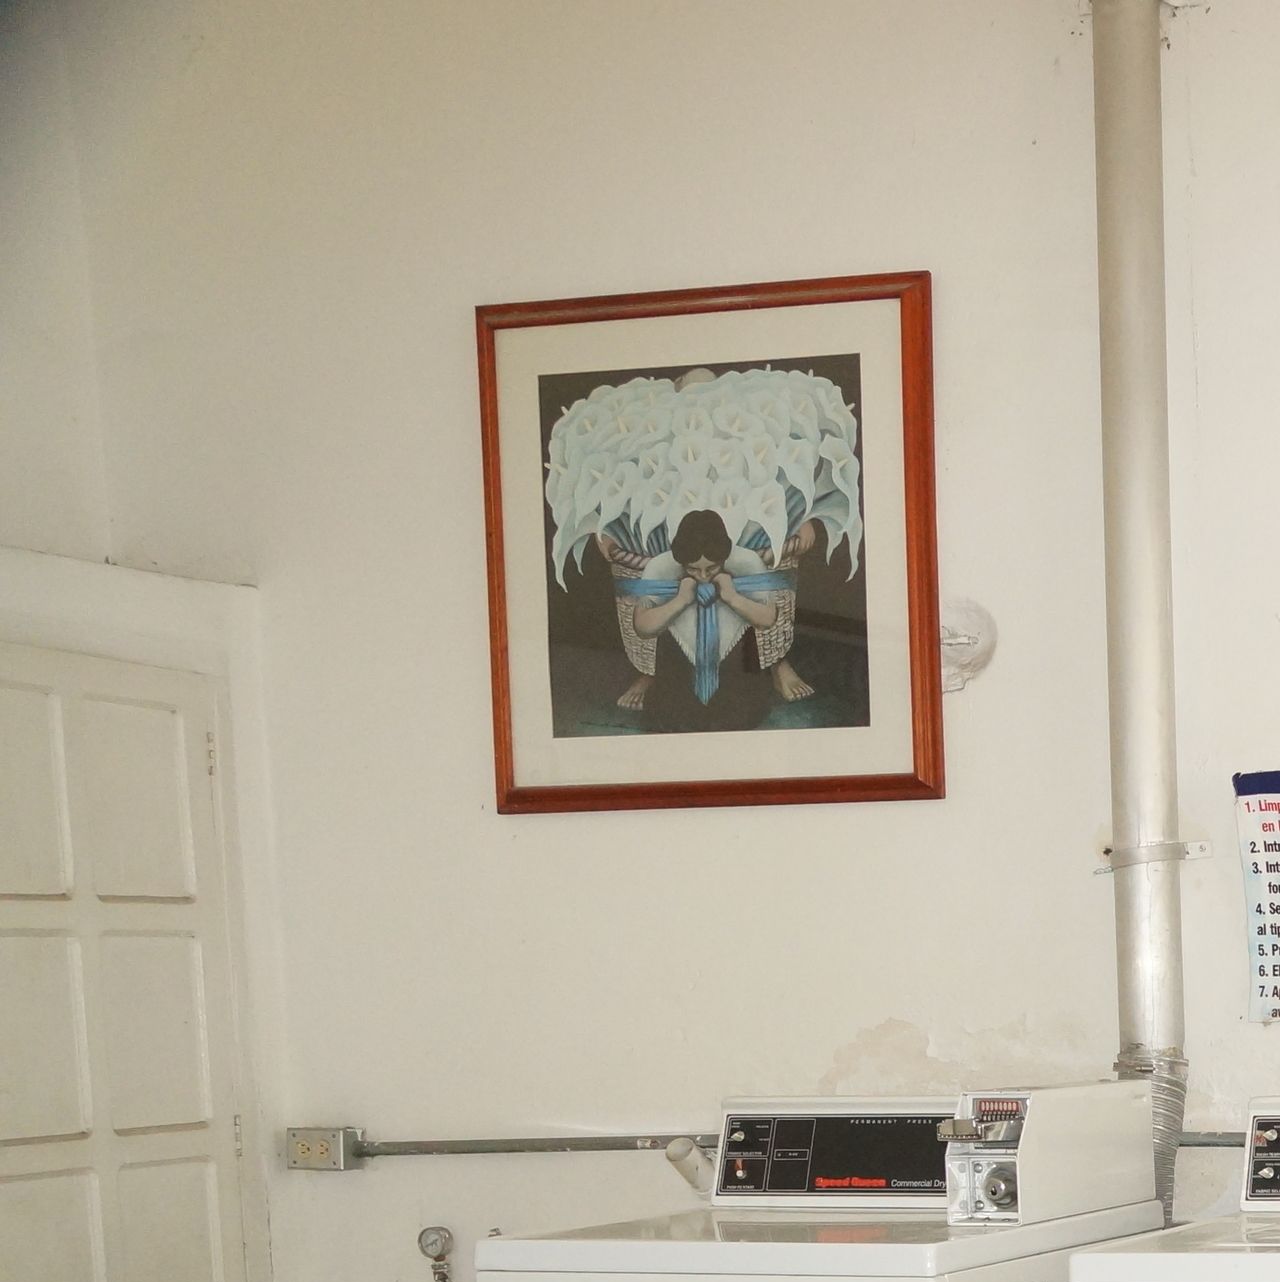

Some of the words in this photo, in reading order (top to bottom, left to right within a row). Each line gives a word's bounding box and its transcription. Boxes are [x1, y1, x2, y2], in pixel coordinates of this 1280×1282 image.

[1245, 800, 1255, 812] 1.
[1262, 822, 1275, 832] en
[1258, 943, 1268, 955] 5.
